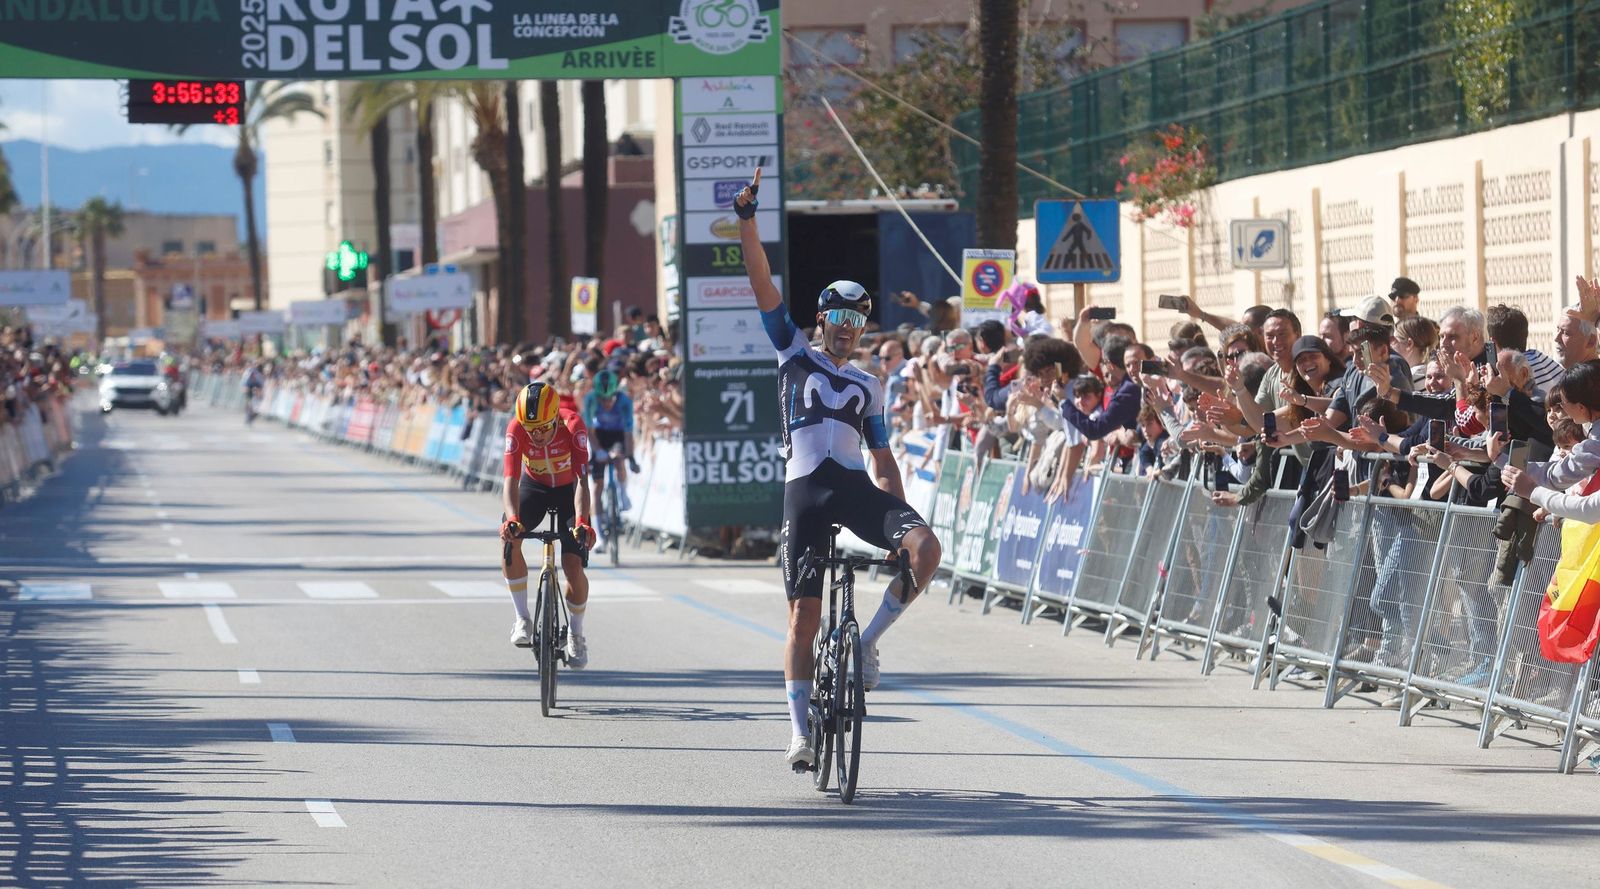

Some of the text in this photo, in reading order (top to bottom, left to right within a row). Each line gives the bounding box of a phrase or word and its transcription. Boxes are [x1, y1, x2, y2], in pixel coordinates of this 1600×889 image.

[513, 13, 620, 26] LA LINEA DE LA
[240, 0, 266, 69] 2025
[267, 22, 509, 71] DEL SOL
[152, 82, 240, 104] 3:55:33
[213, 107, 239, 126] +3
[687, 155, 758, 169] GSPORT
[720, 390, 755, 423] 71
[687, 440, 760, 462] RUTA
[687, 461, 786, 484] DEL SOL
